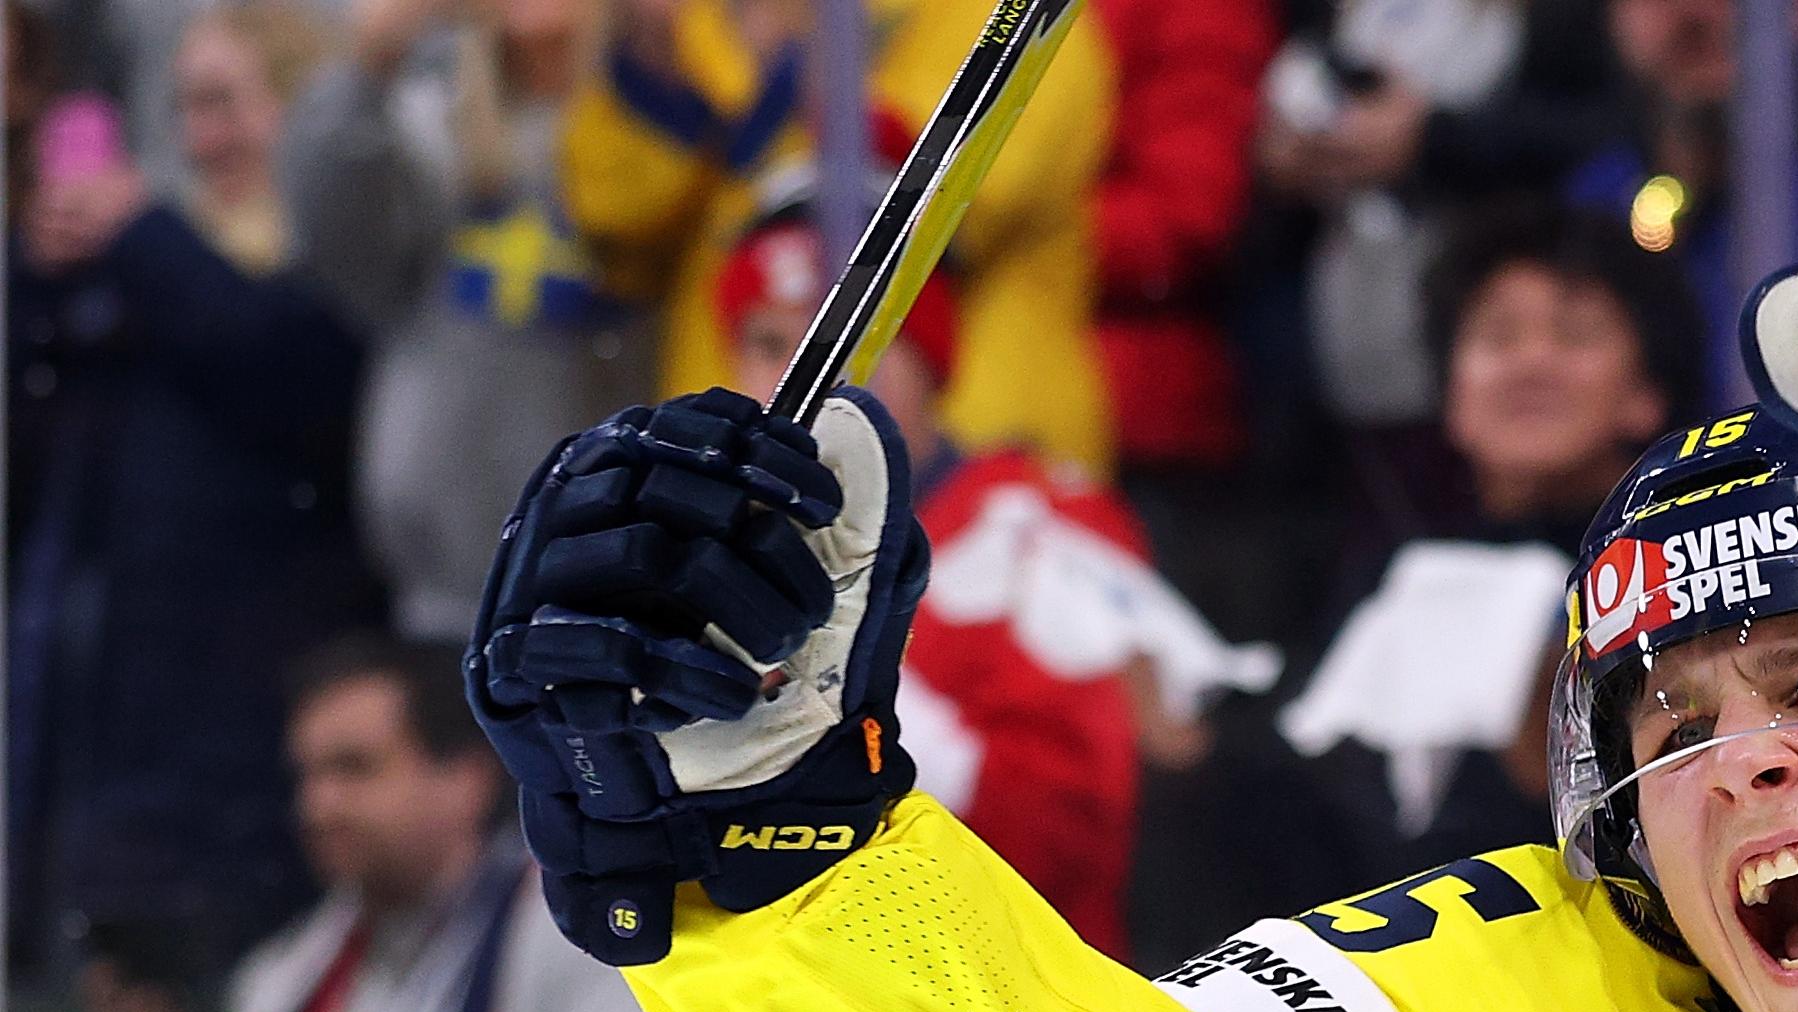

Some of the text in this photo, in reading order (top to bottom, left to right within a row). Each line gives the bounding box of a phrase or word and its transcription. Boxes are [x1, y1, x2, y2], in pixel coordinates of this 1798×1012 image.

[1678, 411, 1755, 460] 15
[1666, 558, 1771, 621] SPEL
[719, 824, 856, 851] CCM
[613, 908, 637, 930] 15
[1155, 961, 1226, 988] EL
